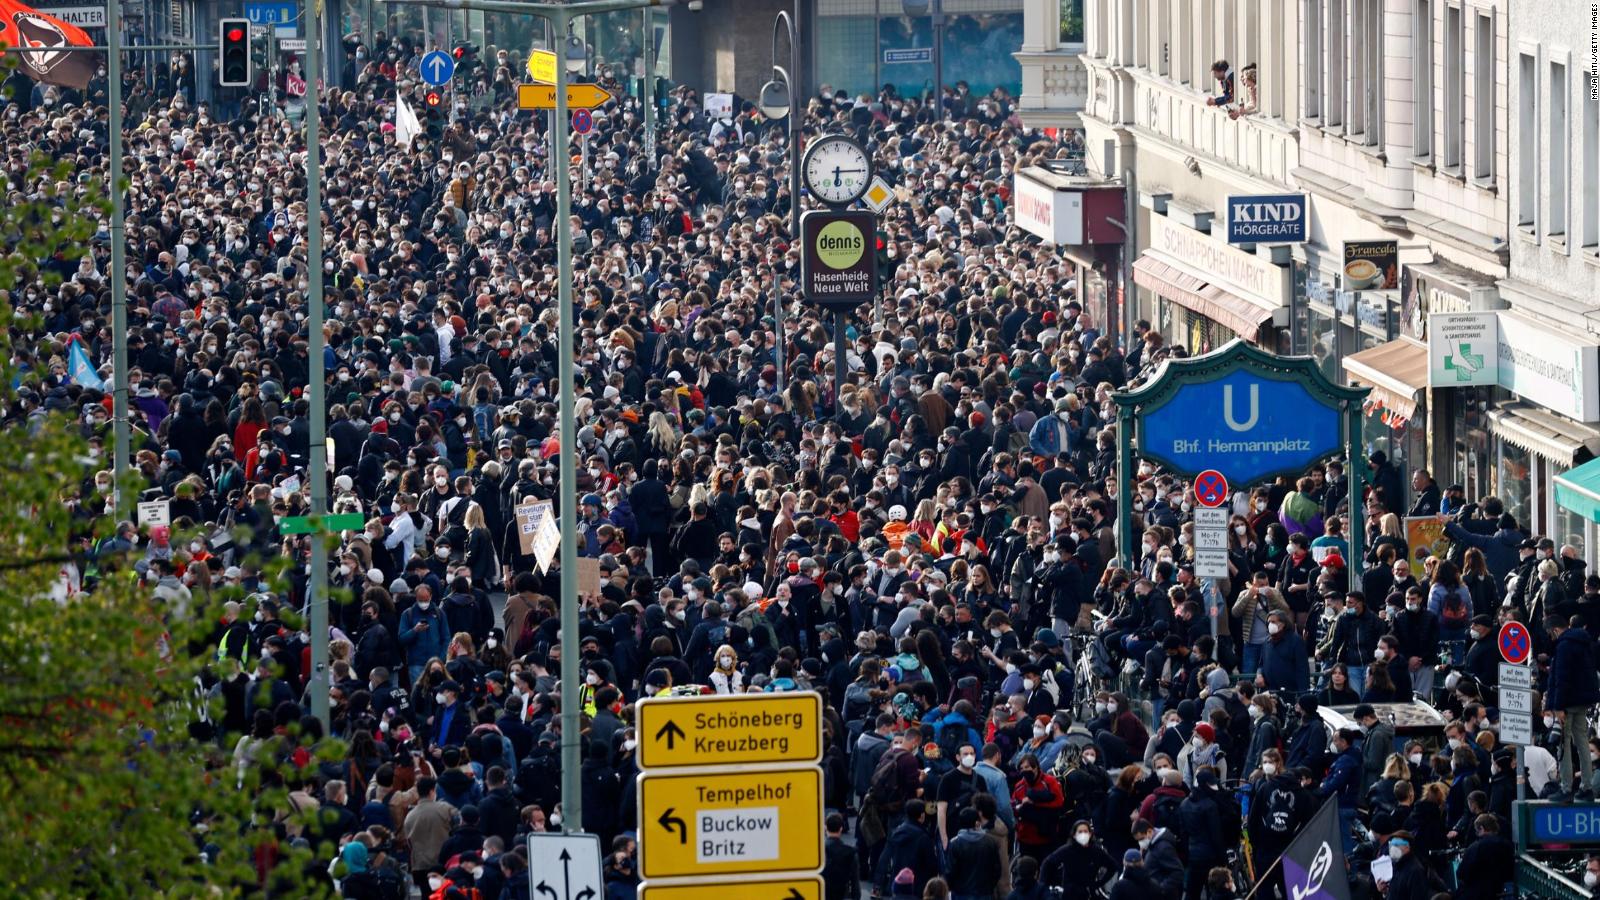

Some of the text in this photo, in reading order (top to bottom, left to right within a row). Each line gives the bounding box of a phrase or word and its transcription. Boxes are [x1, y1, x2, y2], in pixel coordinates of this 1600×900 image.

[63, 12, 102, 22] HALTER
[250, 8, 260, 22] U
[1233, 203, 1301, 222] KIND
[1234, 222, 1300, 235] HÖRGERÄTE
[813, 270, 869, 282] Hasenheide
[814, 281, 869, 293] Neue Welt
[1224, 383, 1259, 431] U
[1174, 438, 1311, 454] Bhf. Hermannplatz
[1506, 692, 1524, 700] Mo-Fr
[695, 710, 803, 730] Schöneberg
[694, 735, 789, 753] Kreuzberg
[696, 782, 792, 805] Tempelhof
[702, 816, 772, 833] Buckow
[702, 840, 745, 856] Britz
